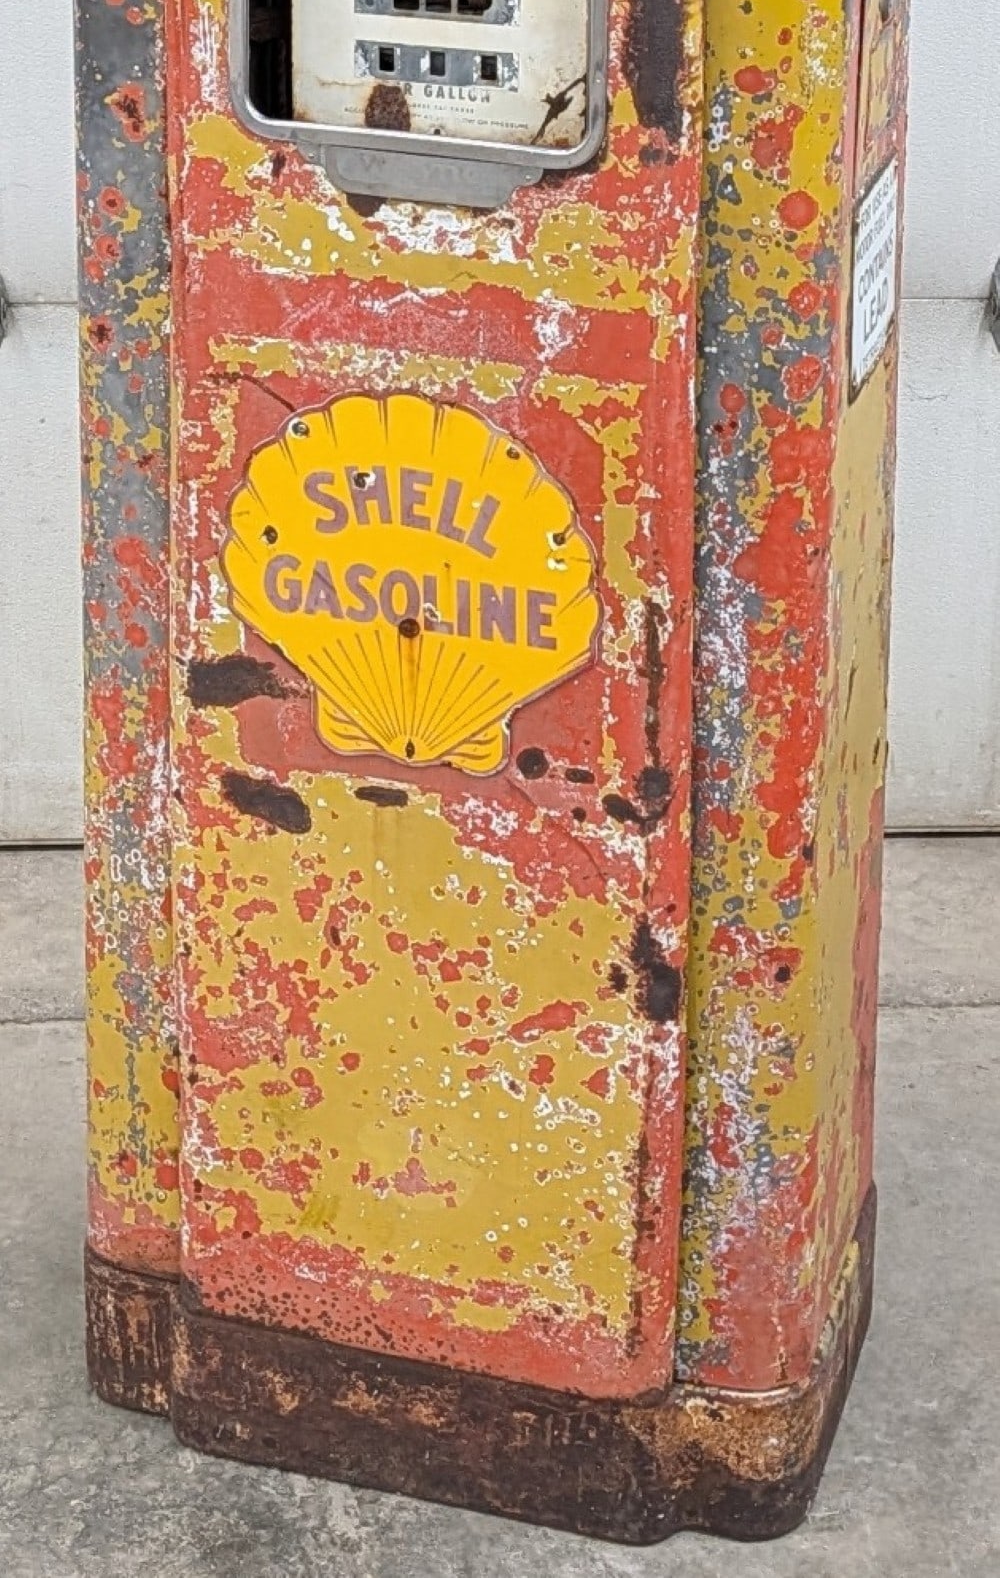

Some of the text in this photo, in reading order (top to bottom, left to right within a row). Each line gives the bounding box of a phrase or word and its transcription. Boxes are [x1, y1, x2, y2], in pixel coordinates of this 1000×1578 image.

[423, 83, 490, 103] GALLON
[858, 228, 893, 304] CONTAINS
[864, 275, 889, 344] LEAD
[303, 465, 501, 559] SHELL
[263, 554, 558, 651] GASOLINE
